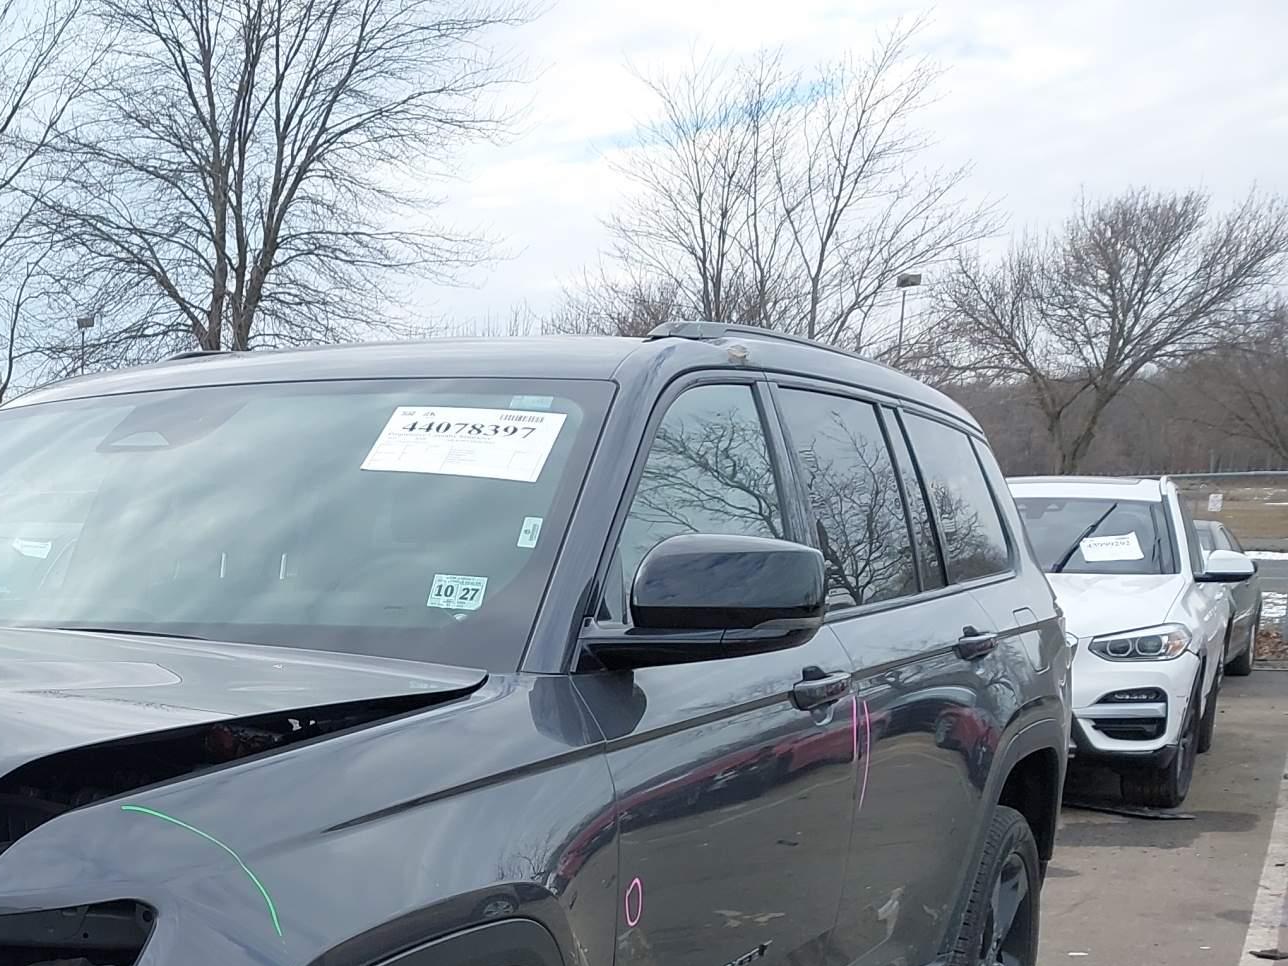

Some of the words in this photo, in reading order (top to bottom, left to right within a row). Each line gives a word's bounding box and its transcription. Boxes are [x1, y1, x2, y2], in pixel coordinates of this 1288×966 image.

[401, 420, 537, 439] 44078397
[433, 583, 455, 598] 10
[458, 587, 481, 601] 27
